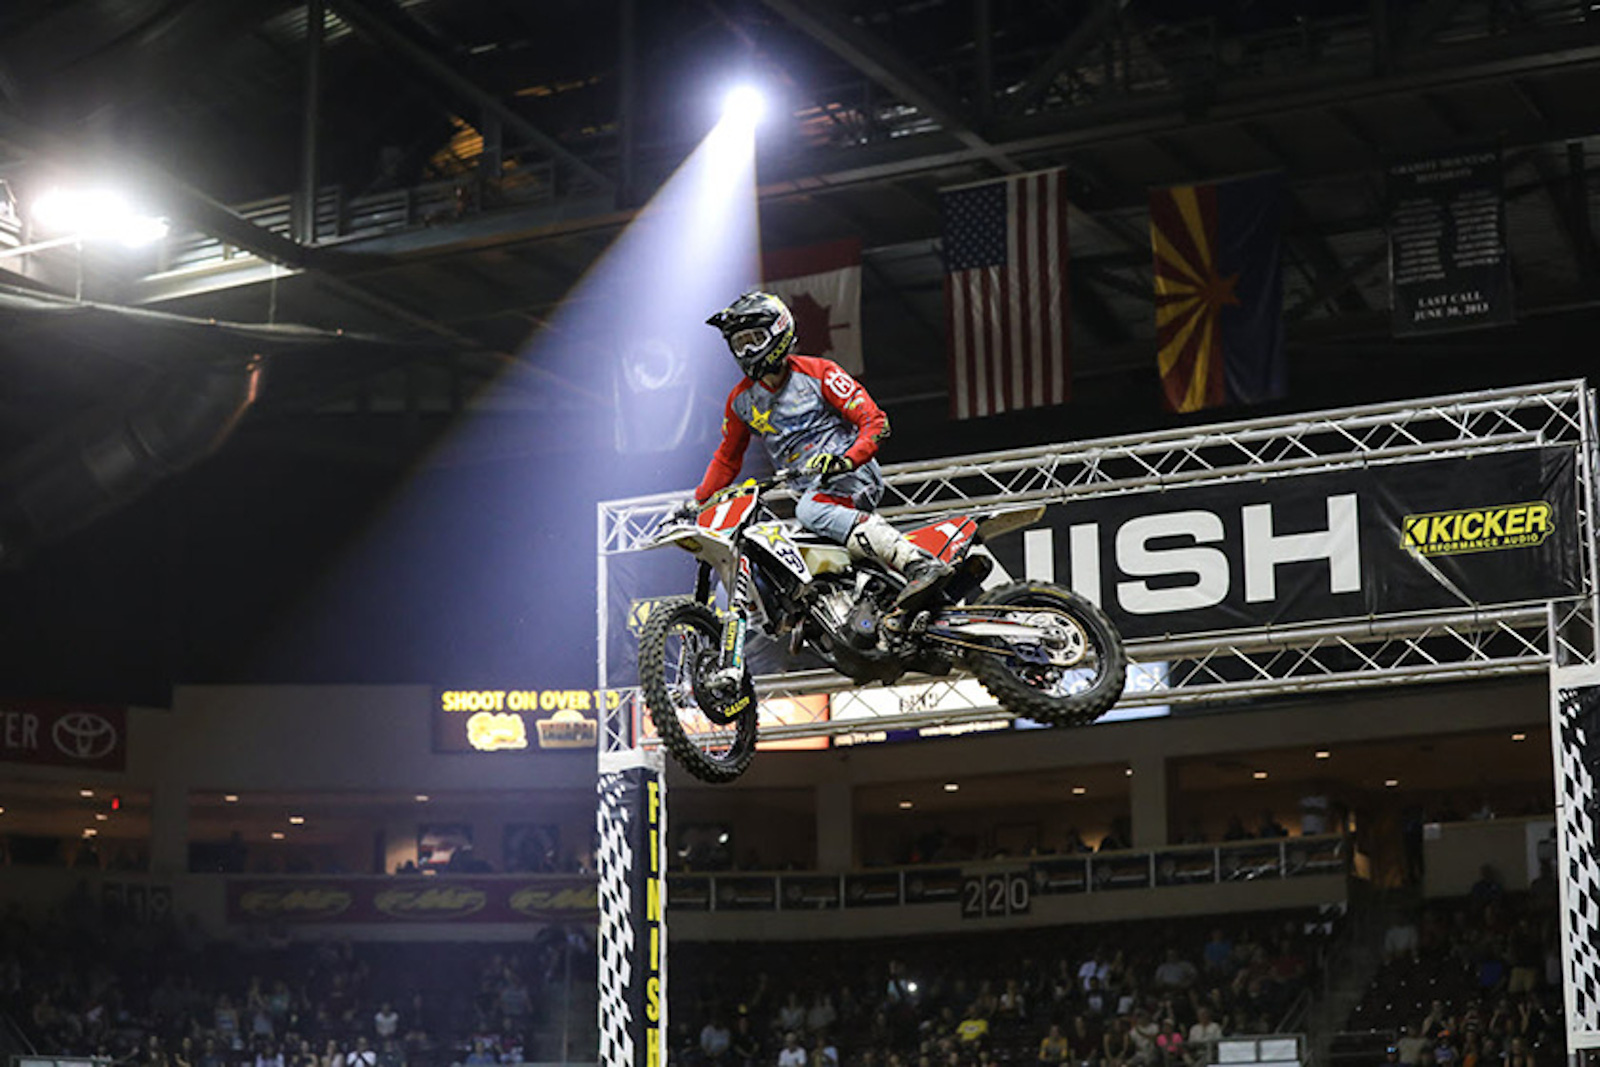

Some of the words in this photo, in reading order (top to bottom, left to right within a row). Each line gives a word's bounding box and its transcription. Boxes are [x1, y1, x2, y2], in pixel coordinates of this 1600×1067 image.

[1414, 307, 1443, 321] JUNE
[1418, 294, 1448, 308] LAST
[1450, 291, 1483, 304] CALL
[710, 500, 733, 530] 1
[1429, 505, 1549, 544] KICKER
[1503, 533, 1539, 545] AUDIO
[442, 691, 506, 711] SHOOT
[508, 691, 538, 711] ON
[540, 691, 591, 710] OVER
[0, 711, 39, 749] ER
[964, 877, 1029, 912] 220
[646, 780, 661, 1067] FINISH
